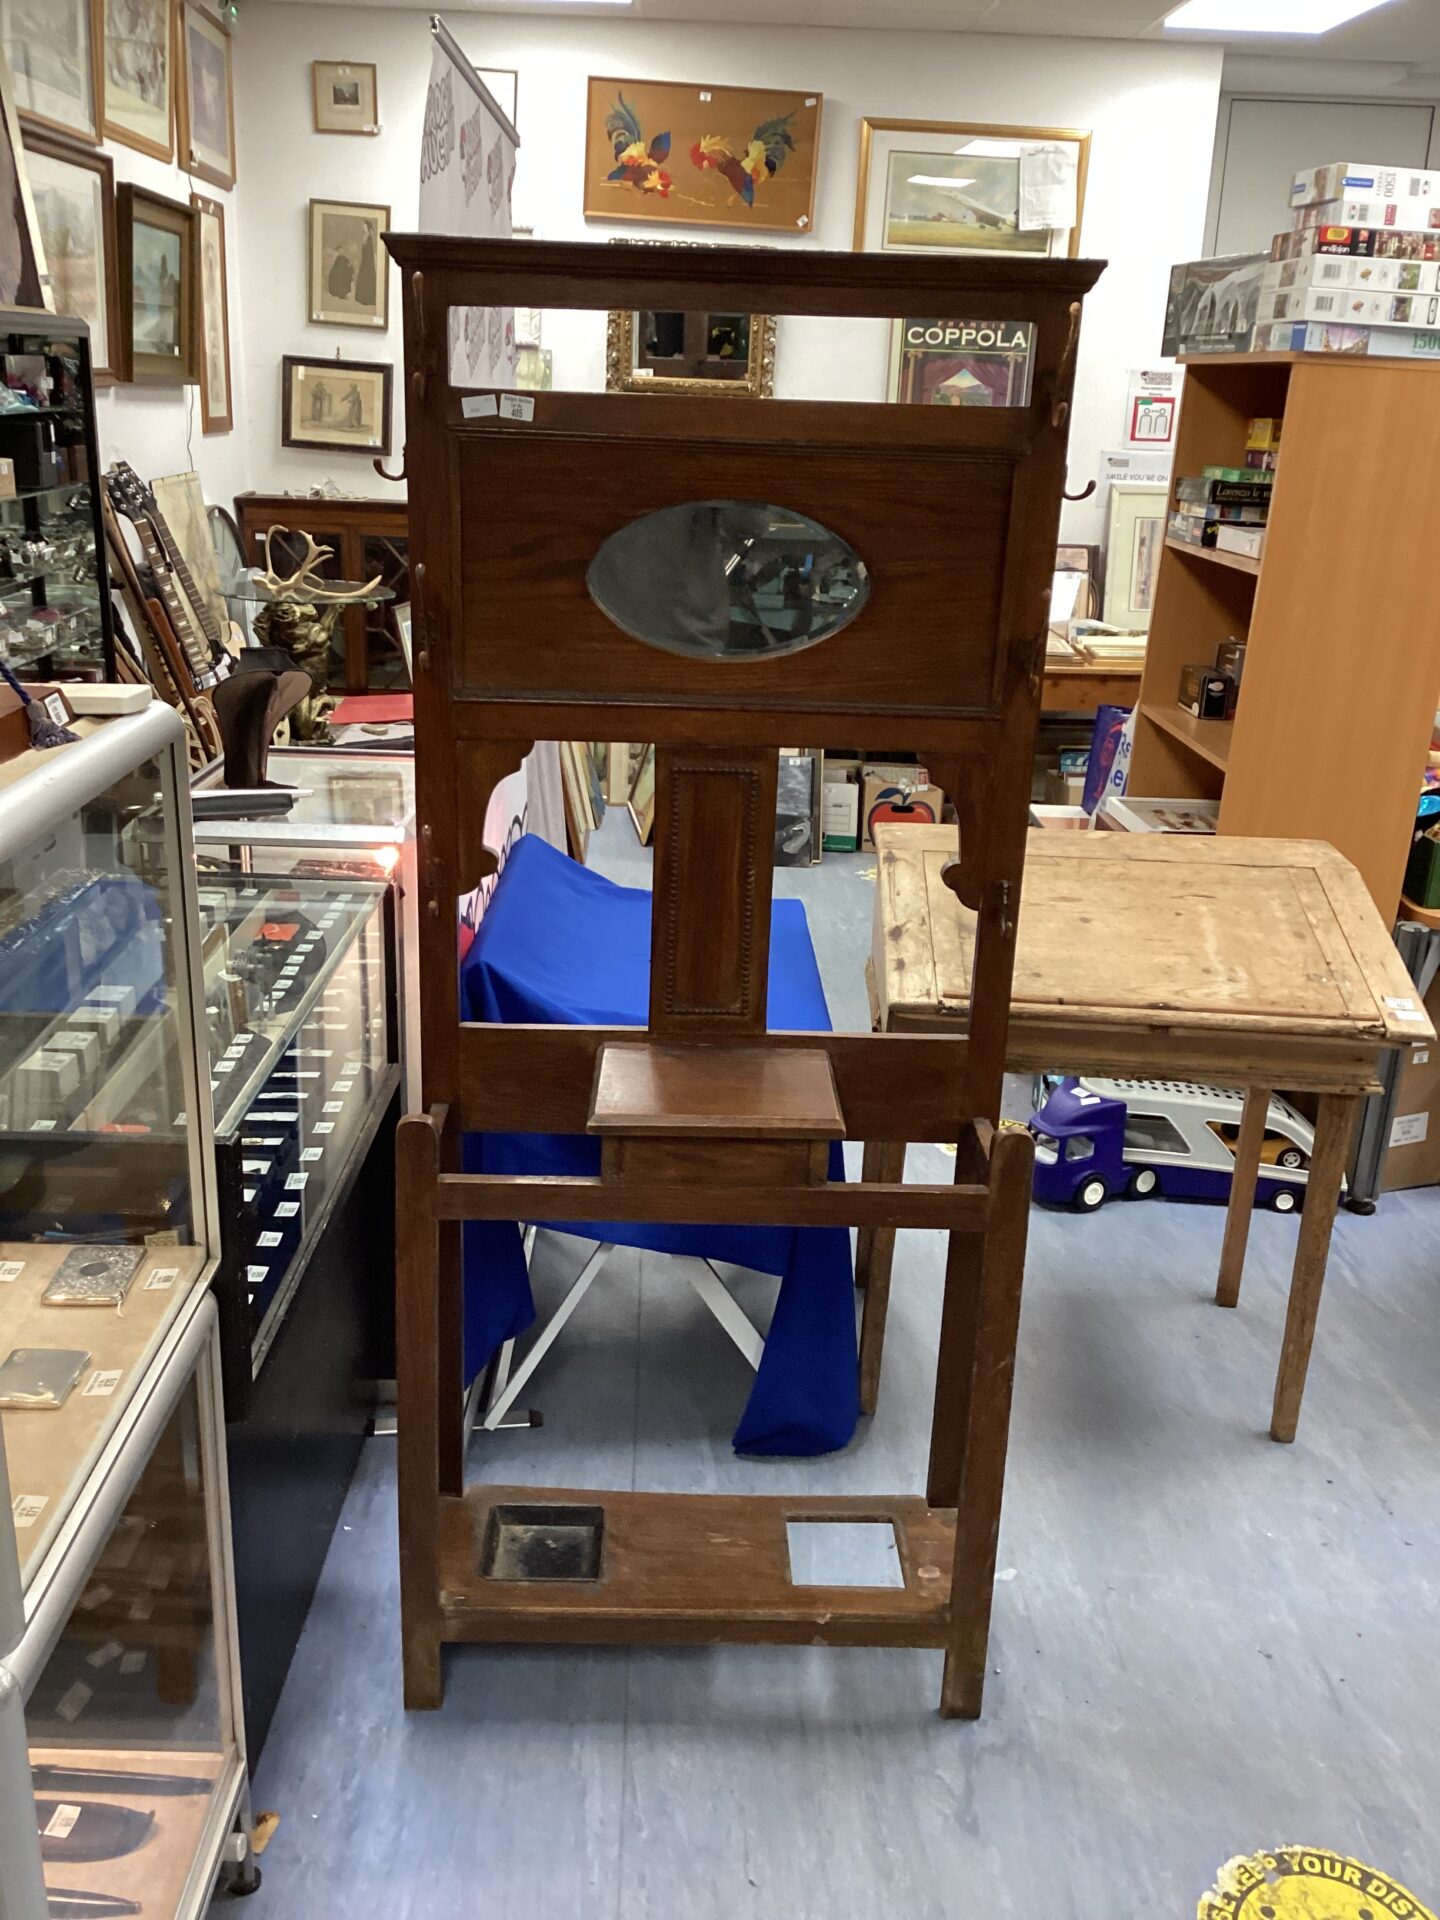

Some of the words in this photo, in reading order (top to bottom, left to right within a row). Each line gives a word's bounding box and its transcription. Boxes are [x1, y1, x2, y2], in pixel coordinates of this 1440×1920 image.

[938, 320, 1006, 330] FRANCIS
[908, 327, 1027, 348] COPPOLA
[1282, 1852, 1362, 1886] YOUR
